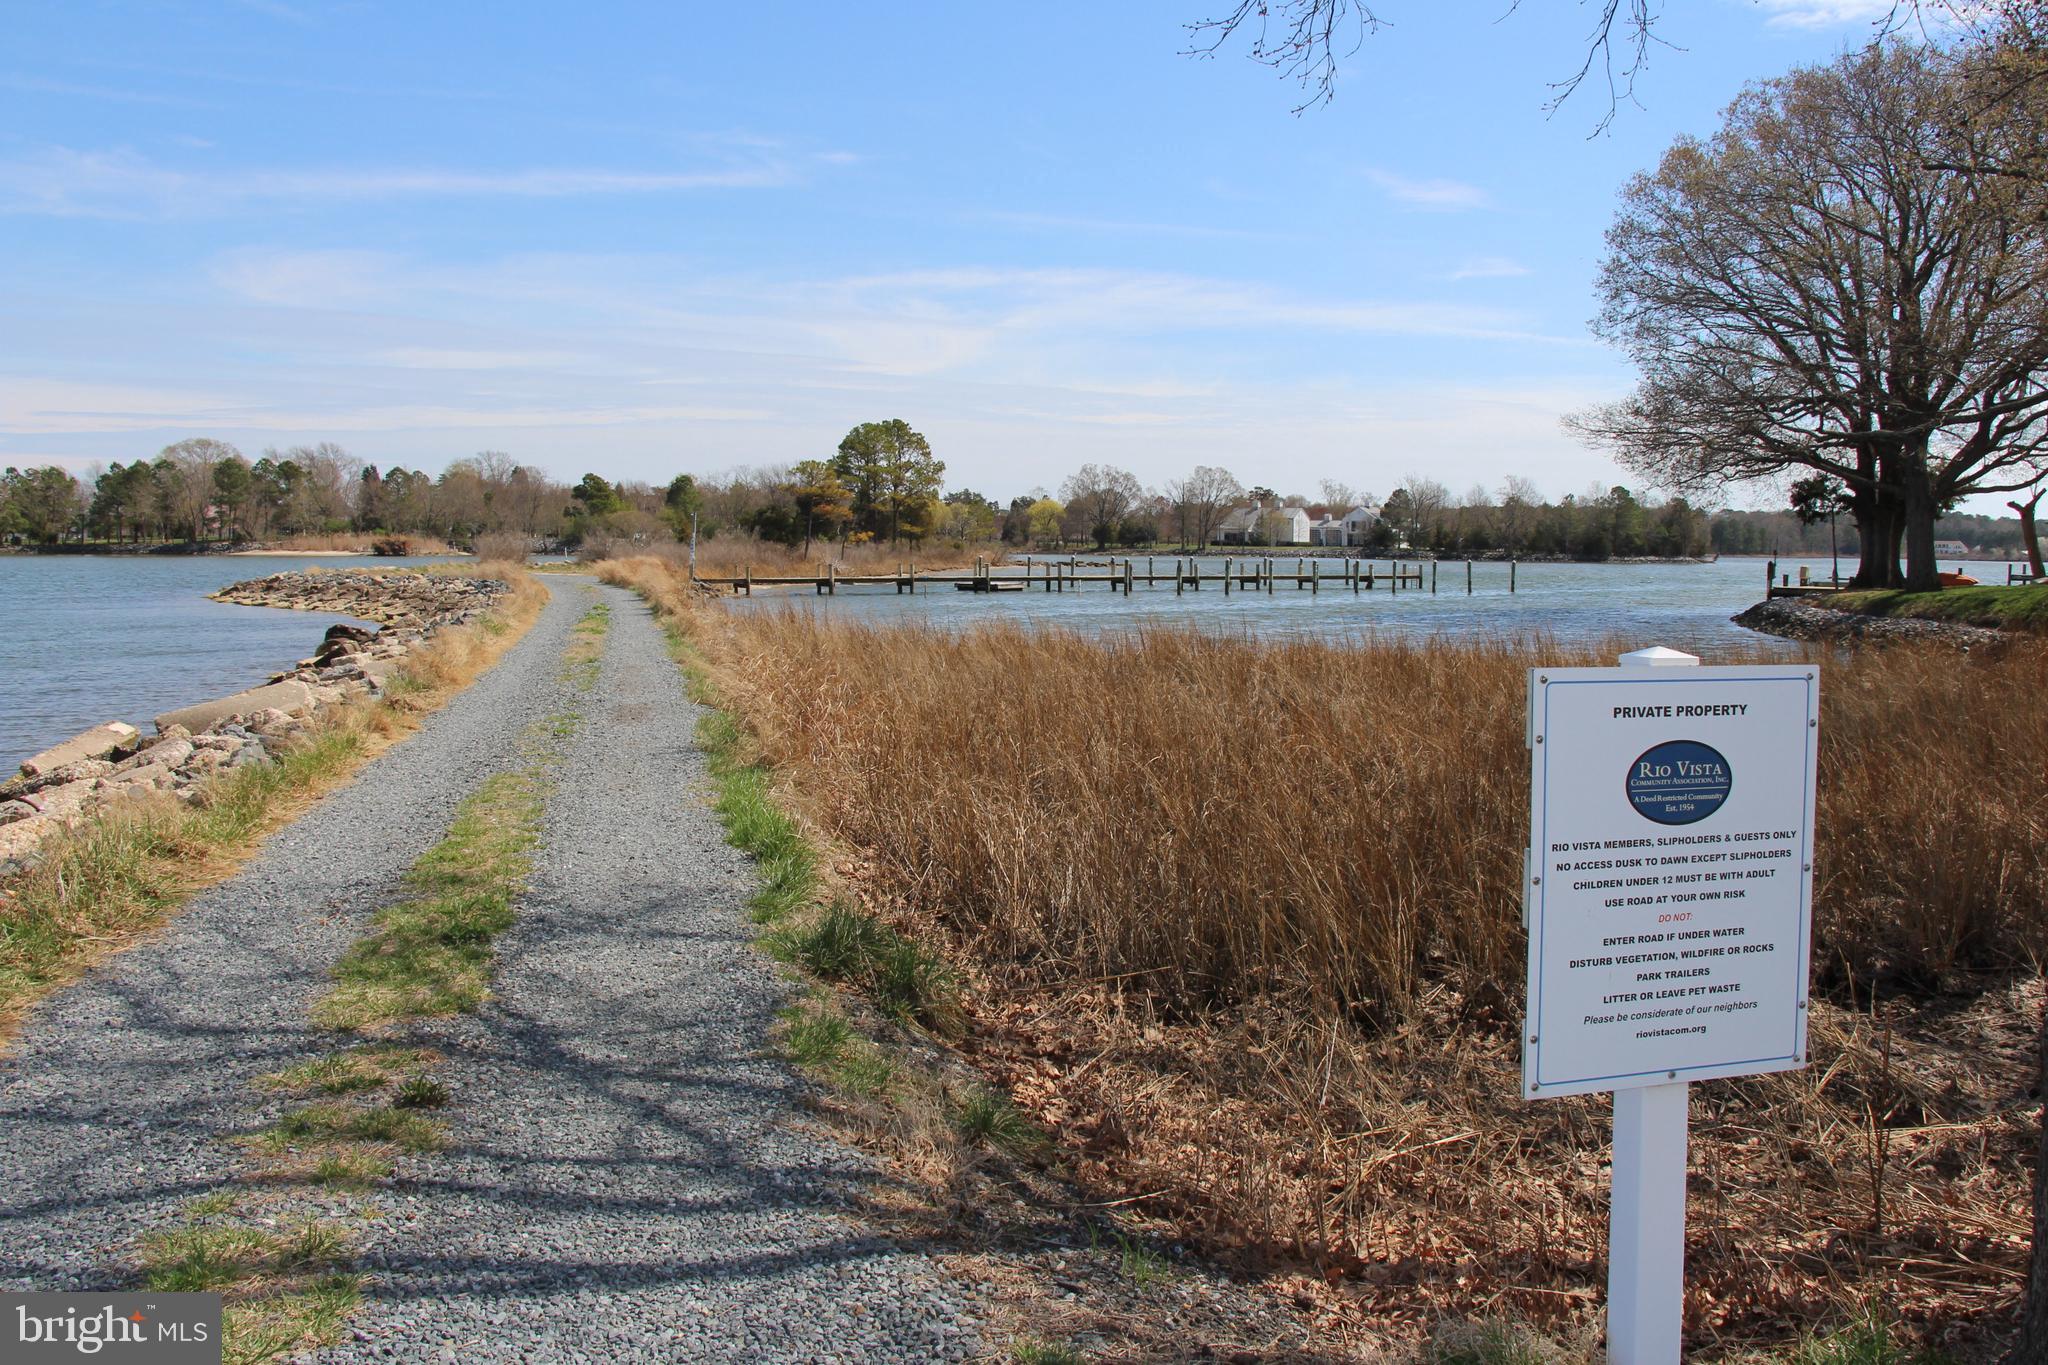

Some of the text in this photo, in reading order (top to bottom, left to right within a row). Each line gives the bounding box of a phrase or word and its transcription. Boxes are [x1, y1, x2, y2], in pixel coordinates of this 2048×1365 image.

[1614, 704, 1747, 718] PRIVATE PROPERTY
[1665, 803, 1695, 812] Est. 1954
[1552, 831, 1796, 852] RIO VISTA MEMBERS, SLIPHOLDERS & GUESTS ONLY
[1557, 850, 1792, 871] NO ACCESS DUSK TO DAWN EXCEPT SLIPHOLDERS
[1573, 869, 1775, 890] CHILDREN UNDER 12 MUST BE WITH ADULT
[1605, 890, 1745, 907] USE ROAD AT YOUR OWN RISK
[1658, 913, 1692, 923] DO NOT:
[1603, 937, 1635, 946] ENTER
[1638, 934, 1664, 943] ROAD
[1678, 931, 1710, 940] UNDER
[1713, 928, 1745, 937] WATER
[1570, 944, 1774, 968] DISTURB VEGETATION, WILDFIRE OR ROCKS
[1637, 968, 1710, 981] PARK TRAILERS
[1603, 984, 1741, 1003] LITTER OR LEAVE PET WASTE
[1584, 1000, 1758, 1024] Please be considerate of our neighbors
[1636, 1025, 1706, 1038] riovistacom.org
